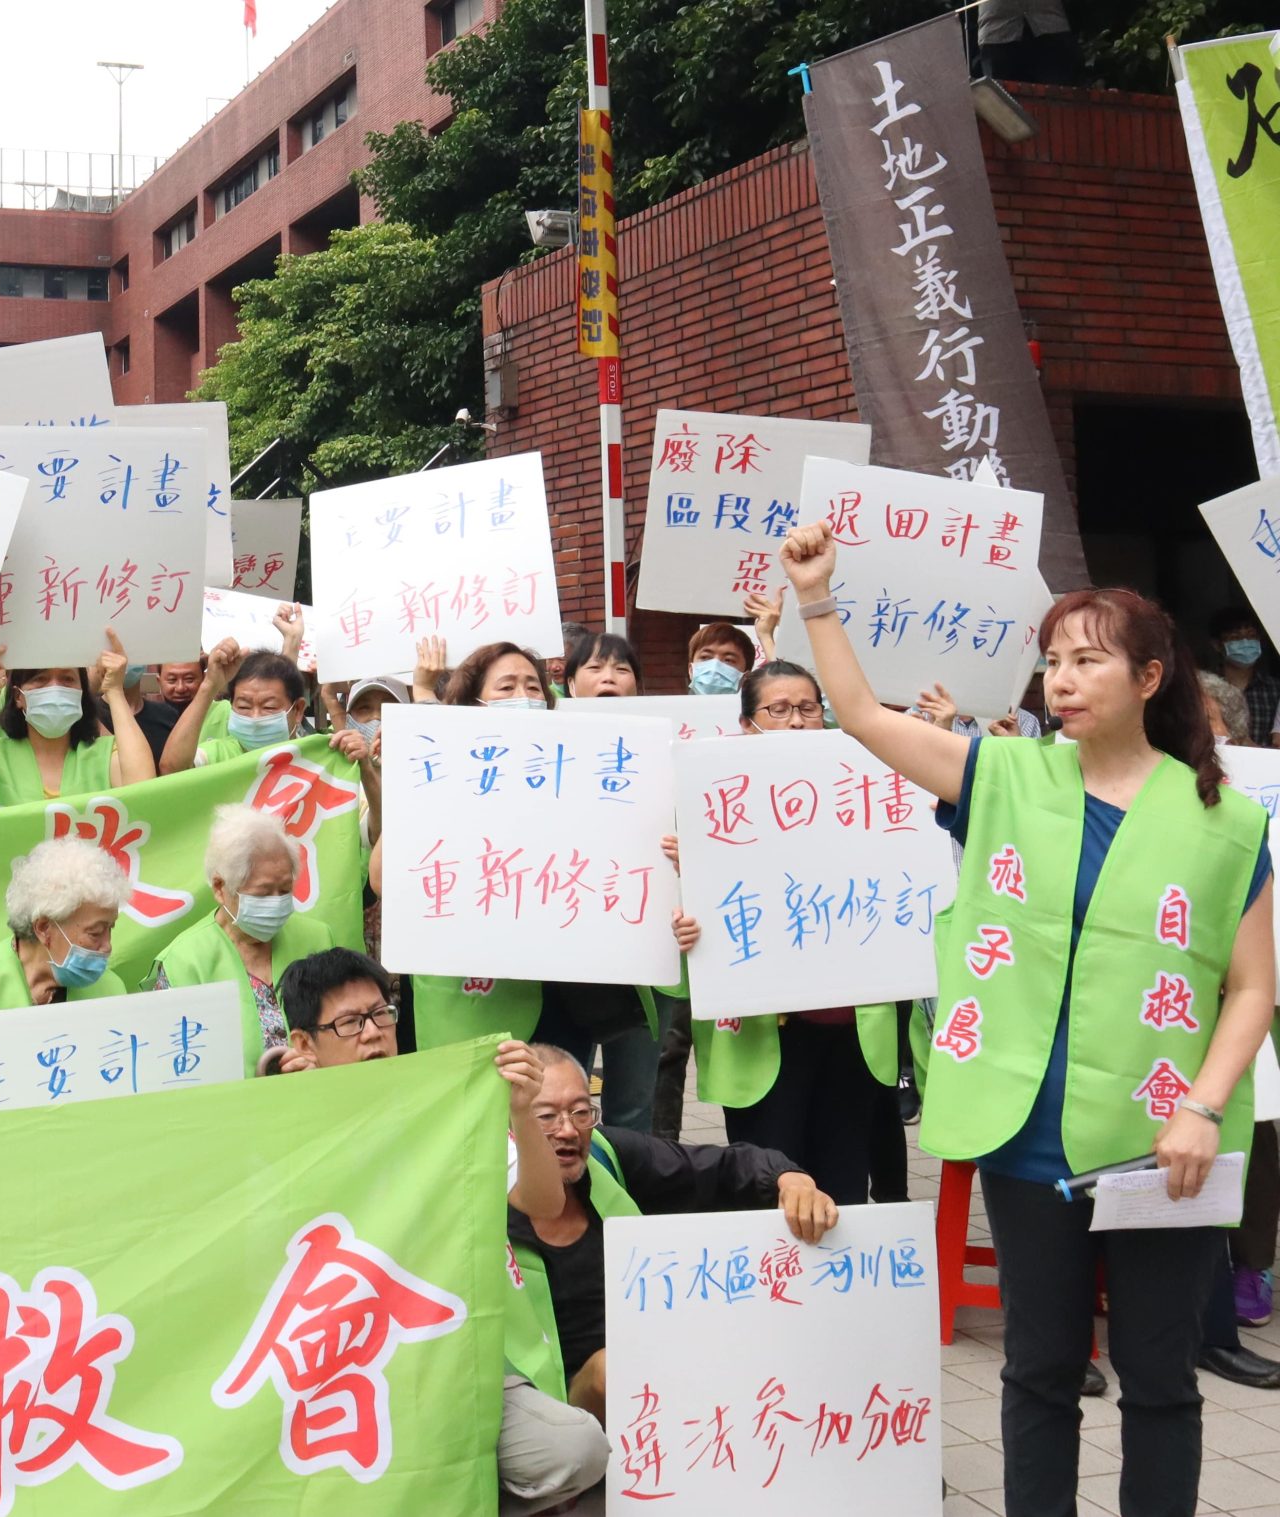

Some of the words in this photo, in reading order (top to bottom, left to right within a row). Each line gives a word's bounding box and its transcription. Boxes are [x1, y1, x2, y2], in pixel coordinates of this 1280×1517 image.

[607, 363, 618, 399] STOP
[656, 422, 772, 475] 廢除
[336, 478, 524, 556] 主要計畫
[330, 566, 544, 649] 重新修訂
[731, 549, 789, 596] 惡
[408, 734, 641, 804] 主要計畫
[703, 763, 919, 846] 退回計畫
[407, 837, 655, 930] 重新修訂
[716, 872, 939, 968] 重新修訂
[935, 846, 1025, 1059] 社子島
[1135, 888, 1199, 1121] 自救會
